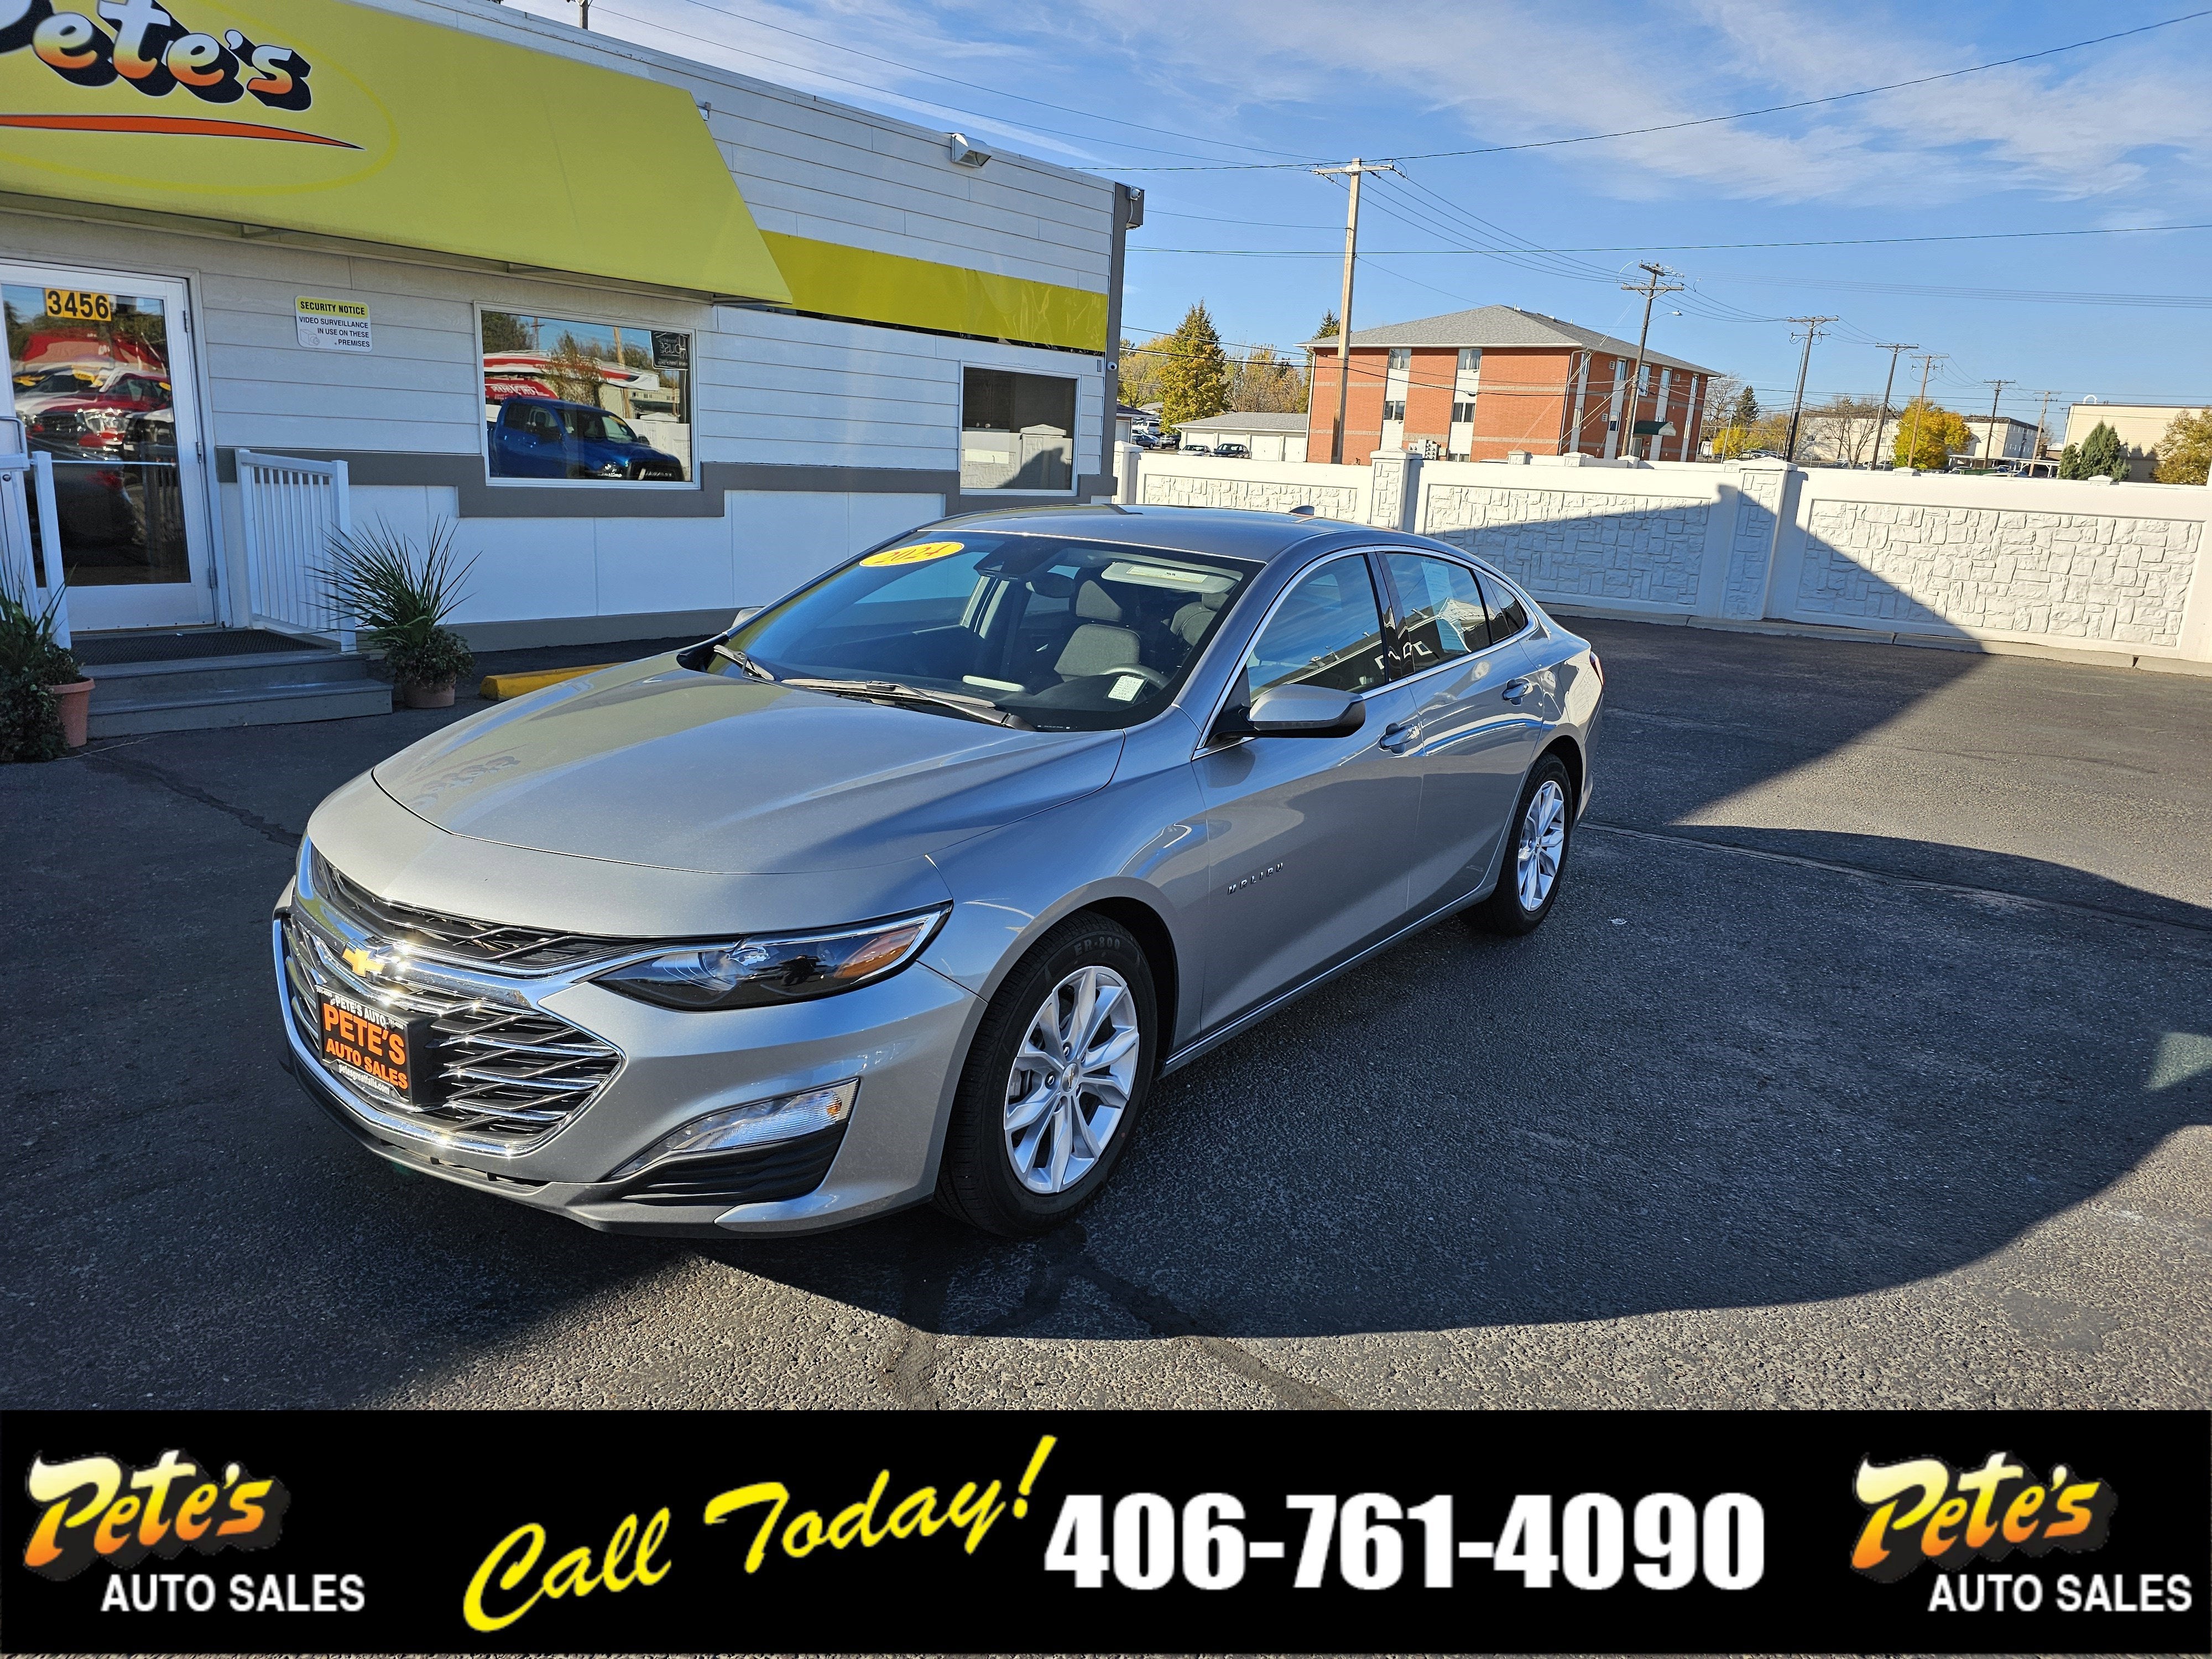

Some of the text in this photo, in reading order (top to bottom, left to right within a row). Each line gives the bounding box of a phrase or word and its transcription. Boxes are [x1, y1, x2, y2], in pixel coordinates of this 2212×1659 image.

[0, 0, 306, 106] ete's
[48, 290, 109, 319] 3456
[300, 301, 365, 315] SECURITY NOTICE
[299, 316, 369, 328] VIDEO SURVEILLANCE
[338, 338, 370, 347] PREMISES
[1227, 862, 1284, 895] MALIBU
[335, 994, 363, 1017] PETE'S
[323, 1003, 406, 1066] PETE'S
[326, 1038, 408, 1090] AUTO SALES
